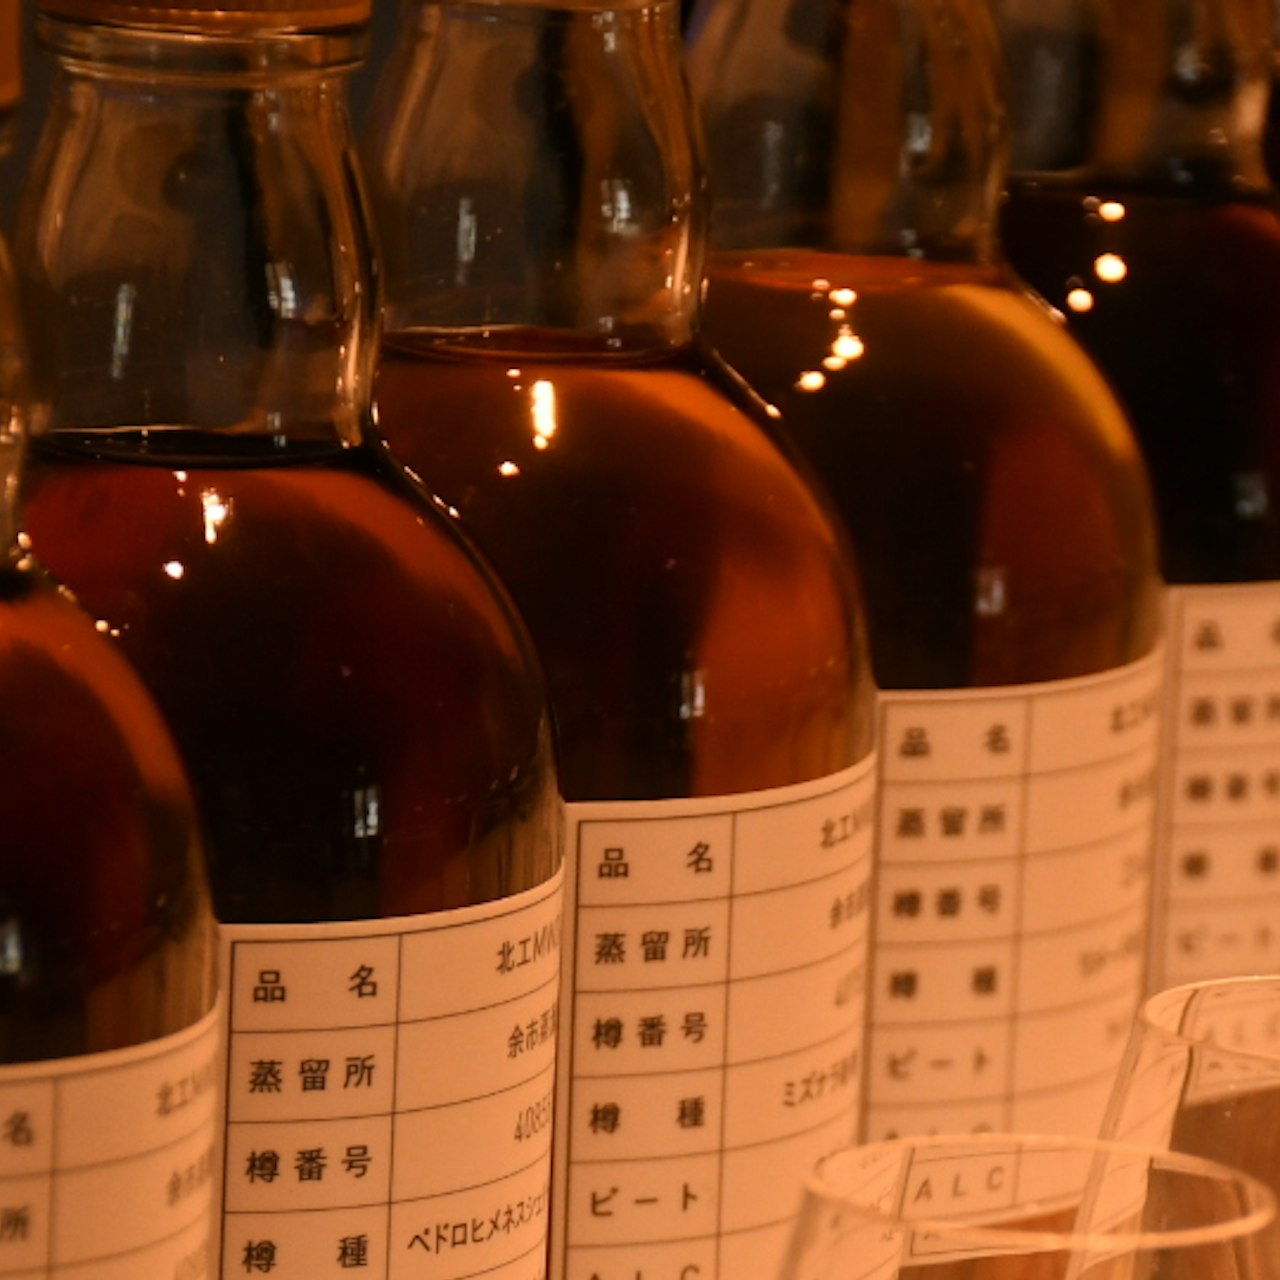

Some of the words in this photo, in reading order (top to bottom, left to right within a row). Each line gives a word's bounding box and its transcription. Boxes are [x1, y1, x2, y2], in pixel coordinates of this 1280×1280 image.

[598, 842, 715, 879] 品名
[594, 926, 711, 964] 蒸留所
[252, 964, 379, 1004] 品名
[249, 1054, 376, 1094] 蒸留所
[245, 1144, 372, 1184] 樽番号
[590, 1181, 698, 1218] ピート
[242, 1234, 369, 1275] 樽種
